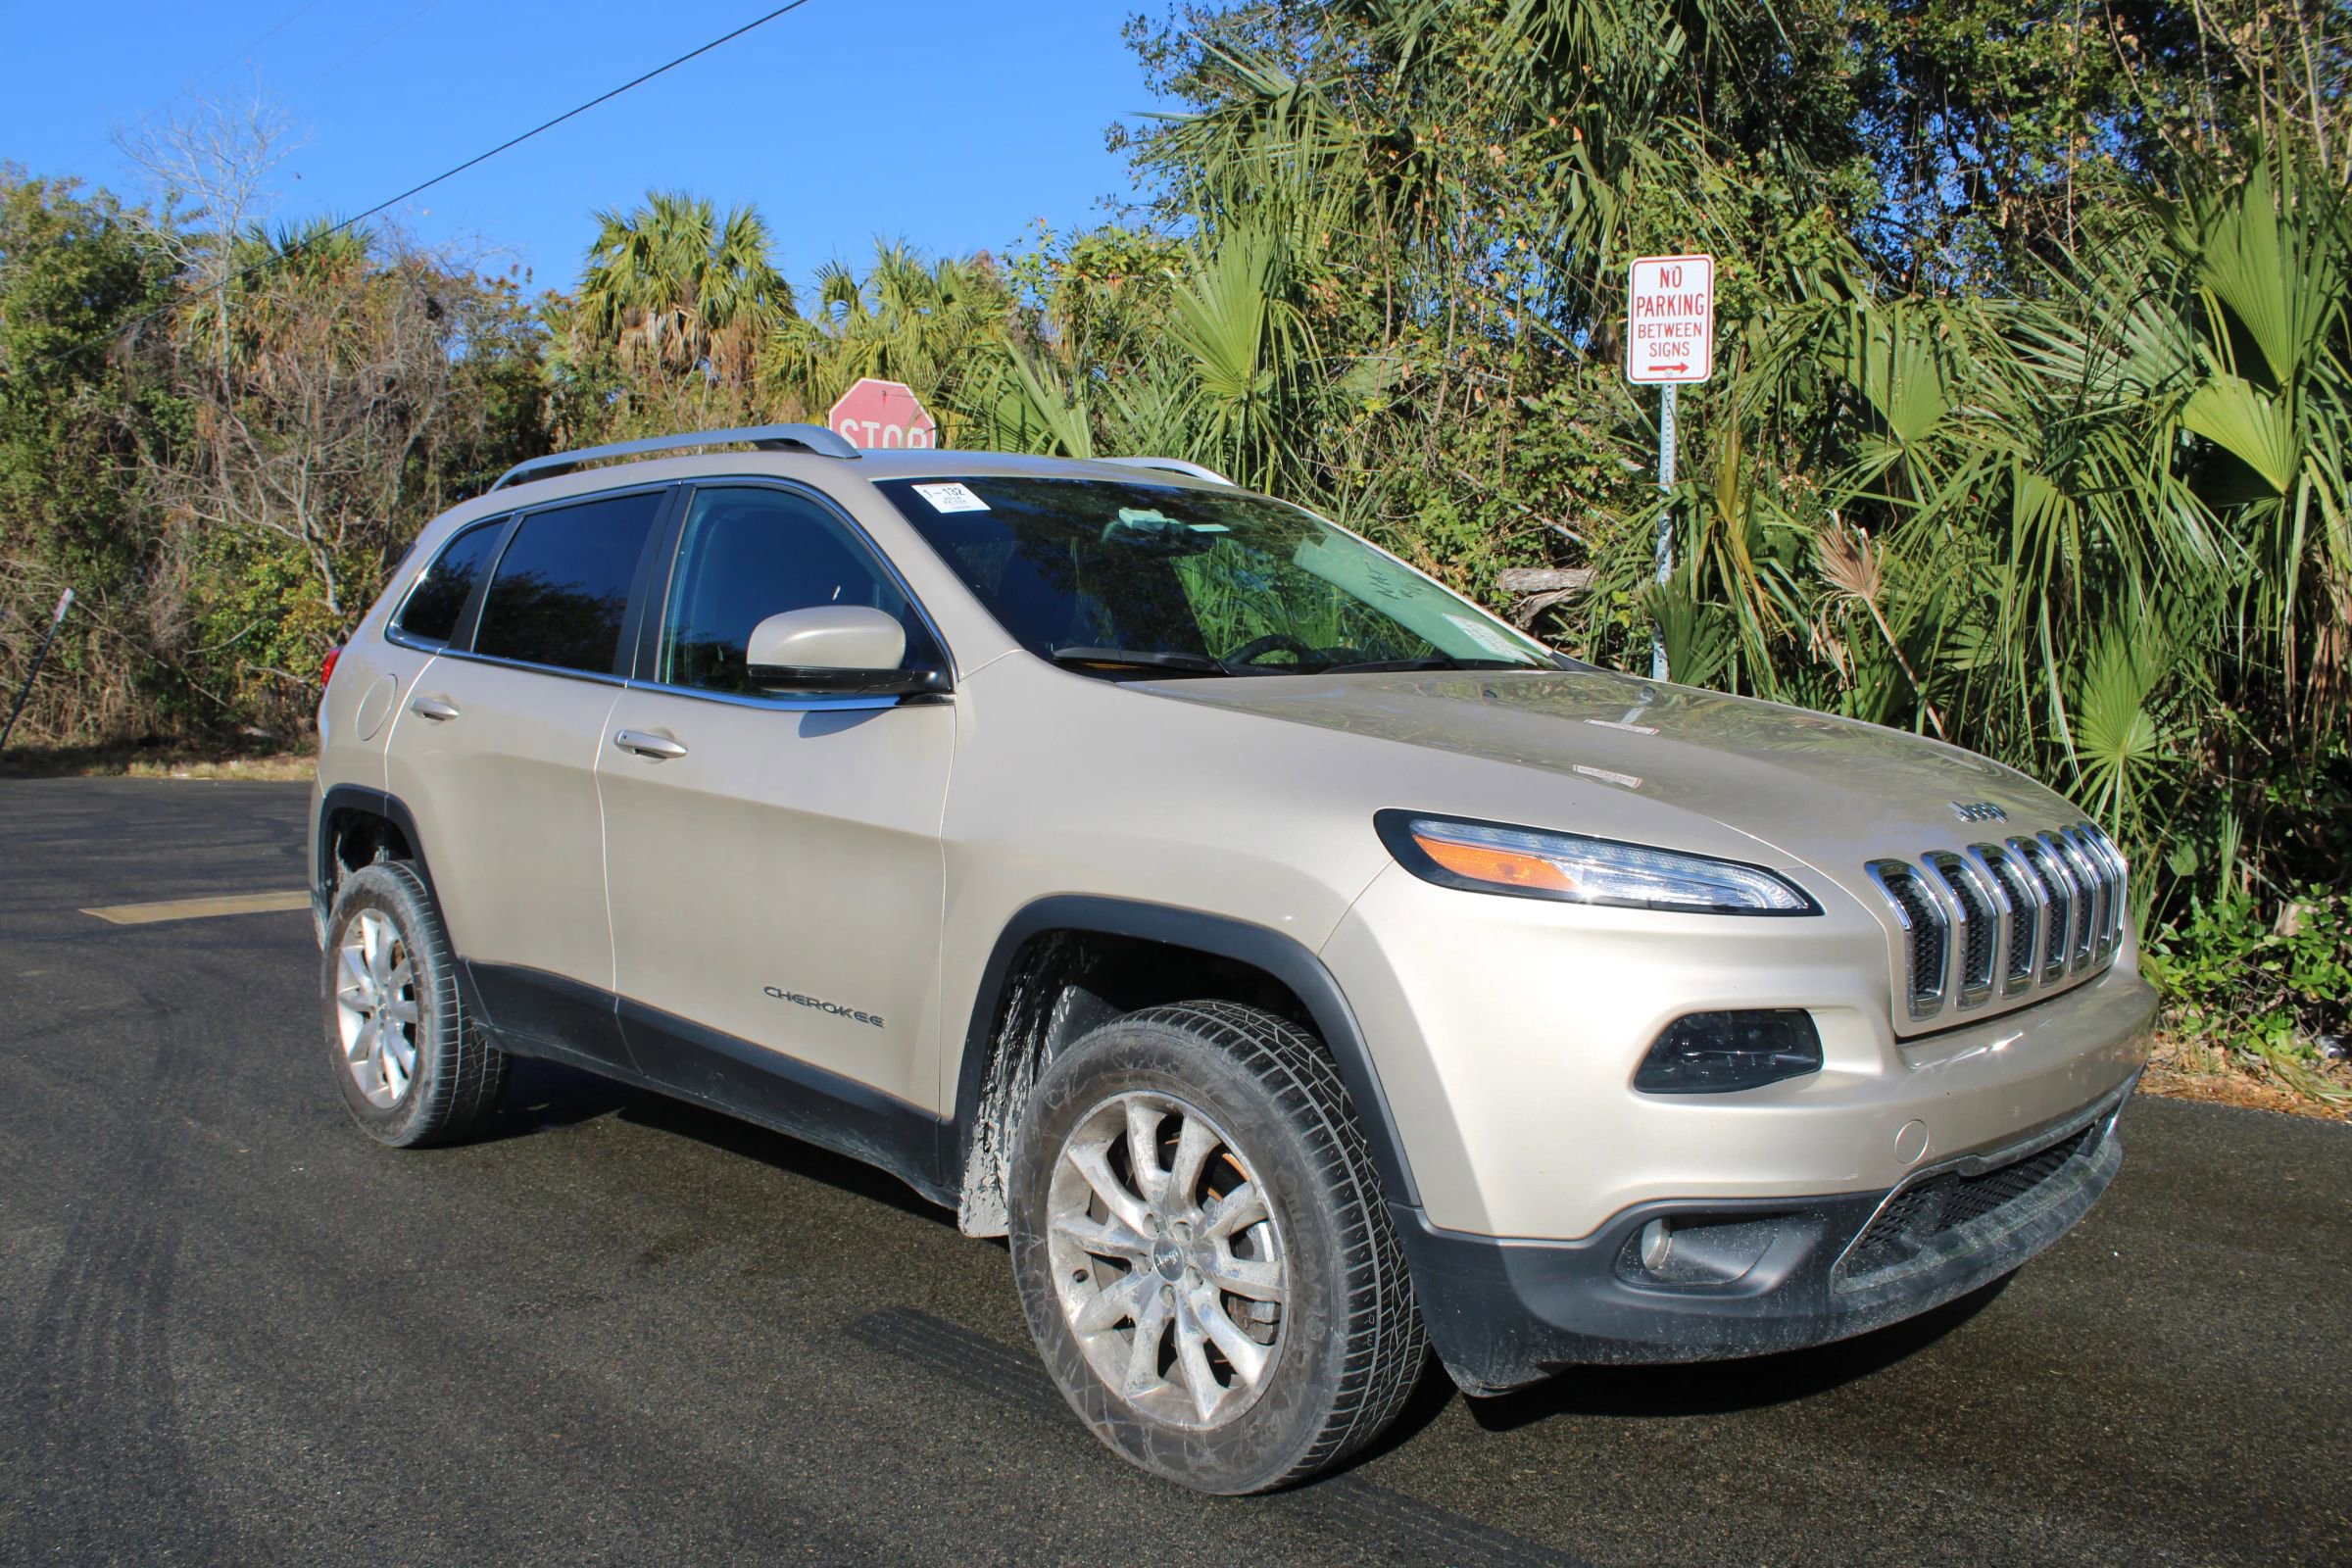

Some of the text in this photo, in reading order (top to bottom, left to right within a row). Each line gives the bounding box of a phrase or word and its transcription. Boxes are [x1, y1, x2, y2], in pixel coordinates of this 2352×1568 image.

[1659, 266, 1683, 288] NO
[1636, 294, 1704, 318] PARKING
[1638, 322, 1702, 339] BETWEEN
[1648, 341, 1690, 358] SIGNS
[1947, 801, 2008, 823] Jeep
[763, 986, 886, 1029] CHEROKEE
